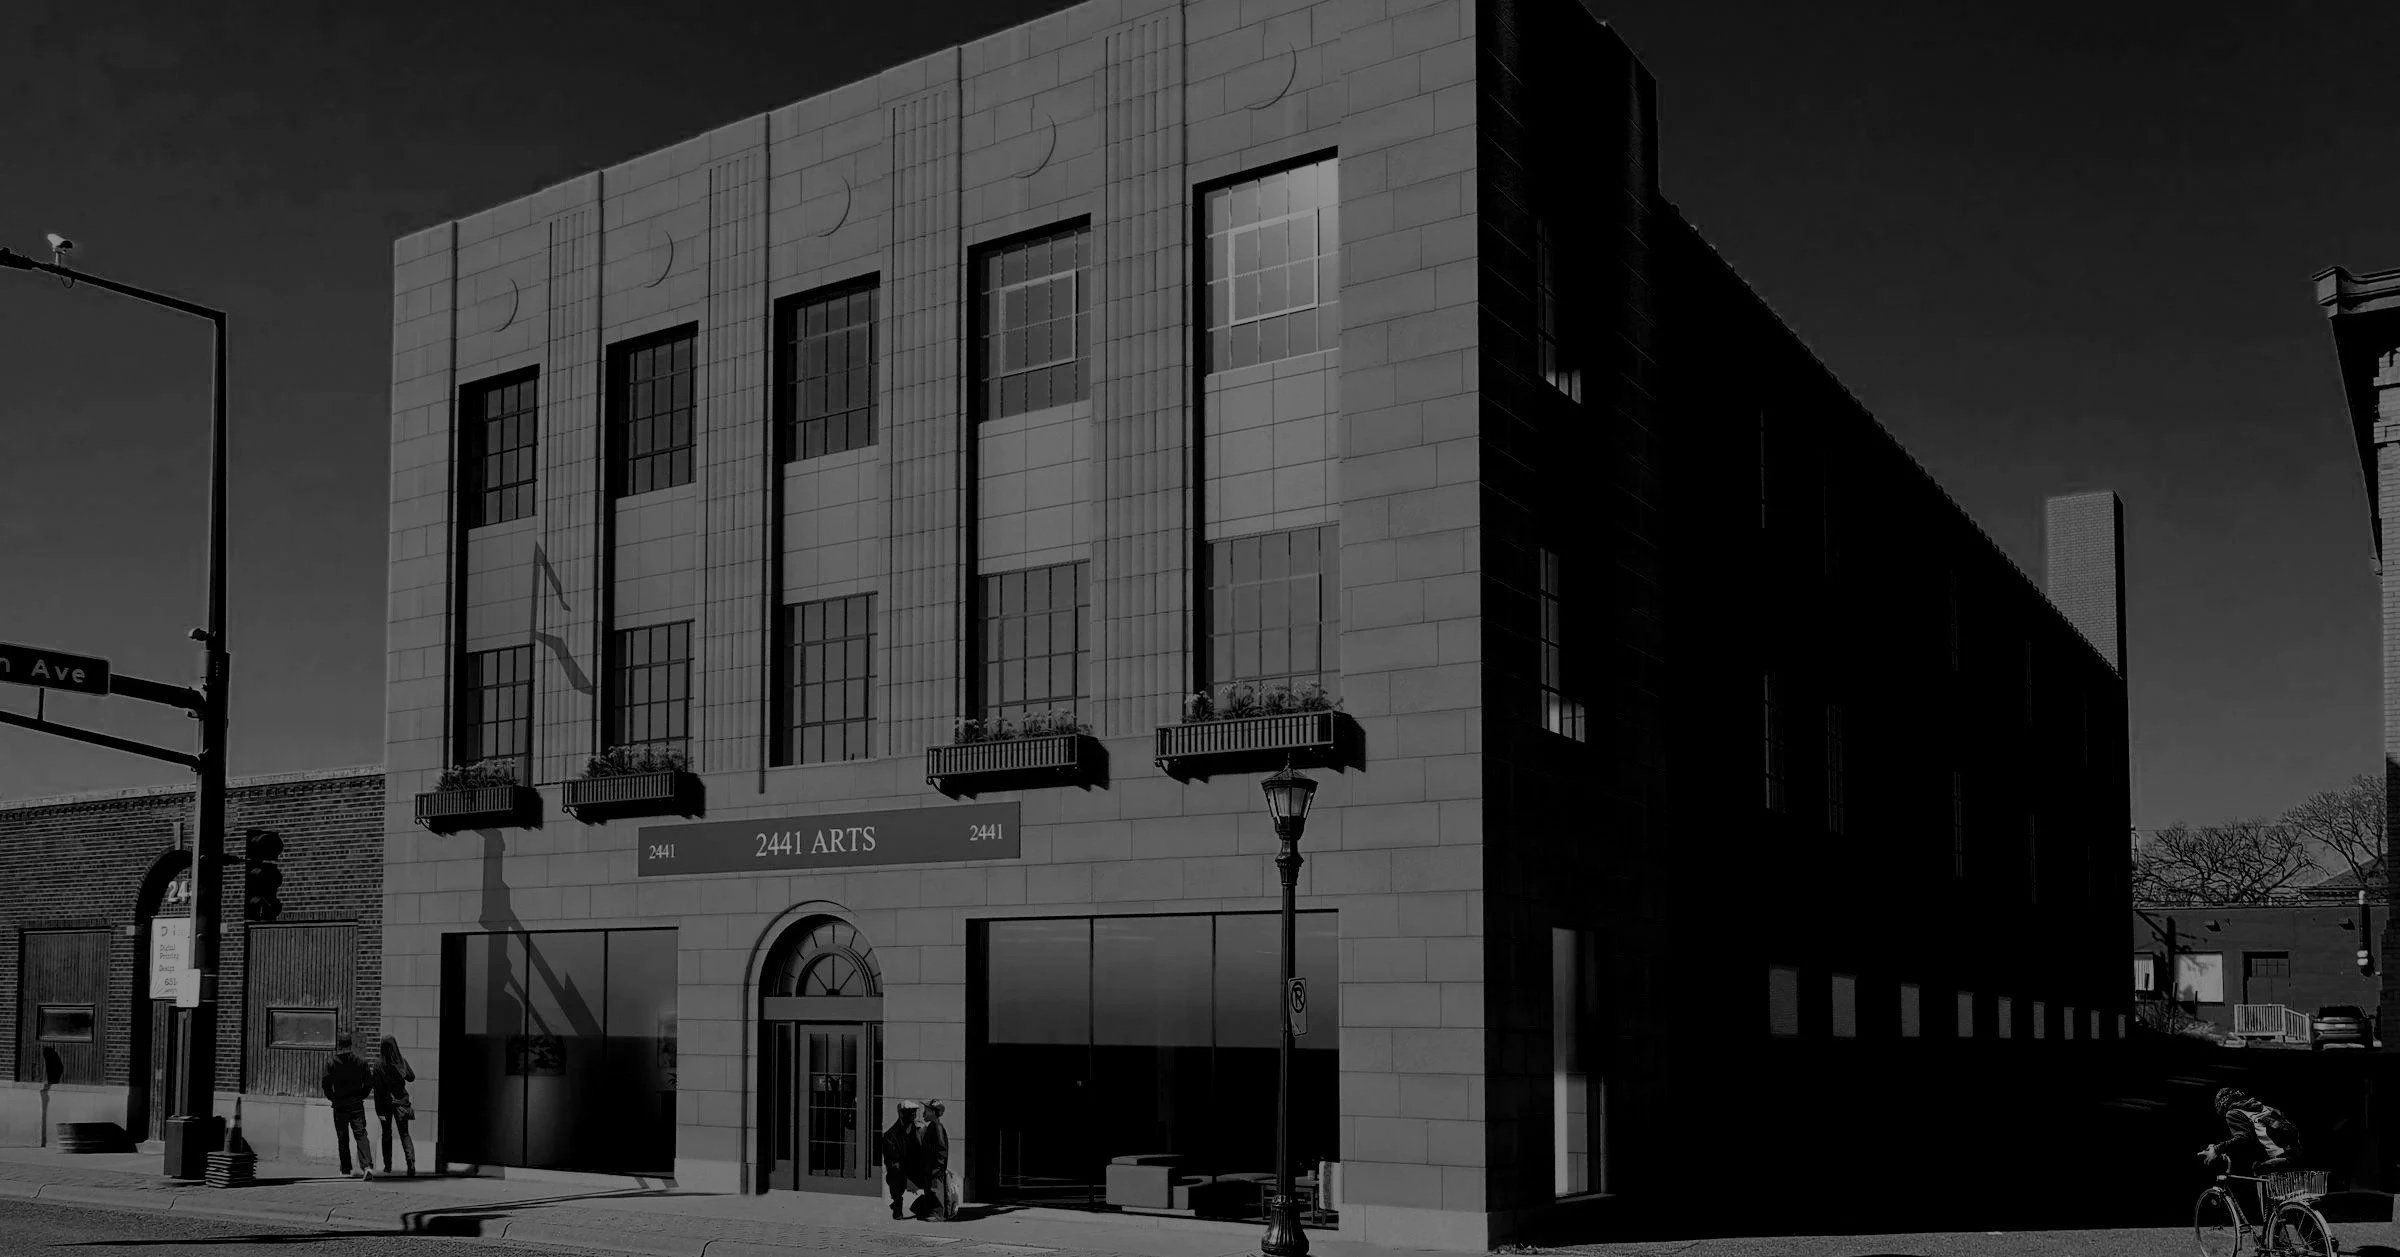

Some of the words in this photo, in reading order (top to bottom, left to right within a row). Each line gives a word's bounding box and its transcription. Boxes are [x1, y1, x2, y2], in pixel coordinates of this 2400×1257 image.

[31, 659, 85, 683] Ave
[755, 831, 801, 857] 2441
[810, 826, 876, 854] ARTS
[969, 823, 1004, 841] 2441
[649, 844, 676, 859] 2441
[168, 881, 192, 902] 24
